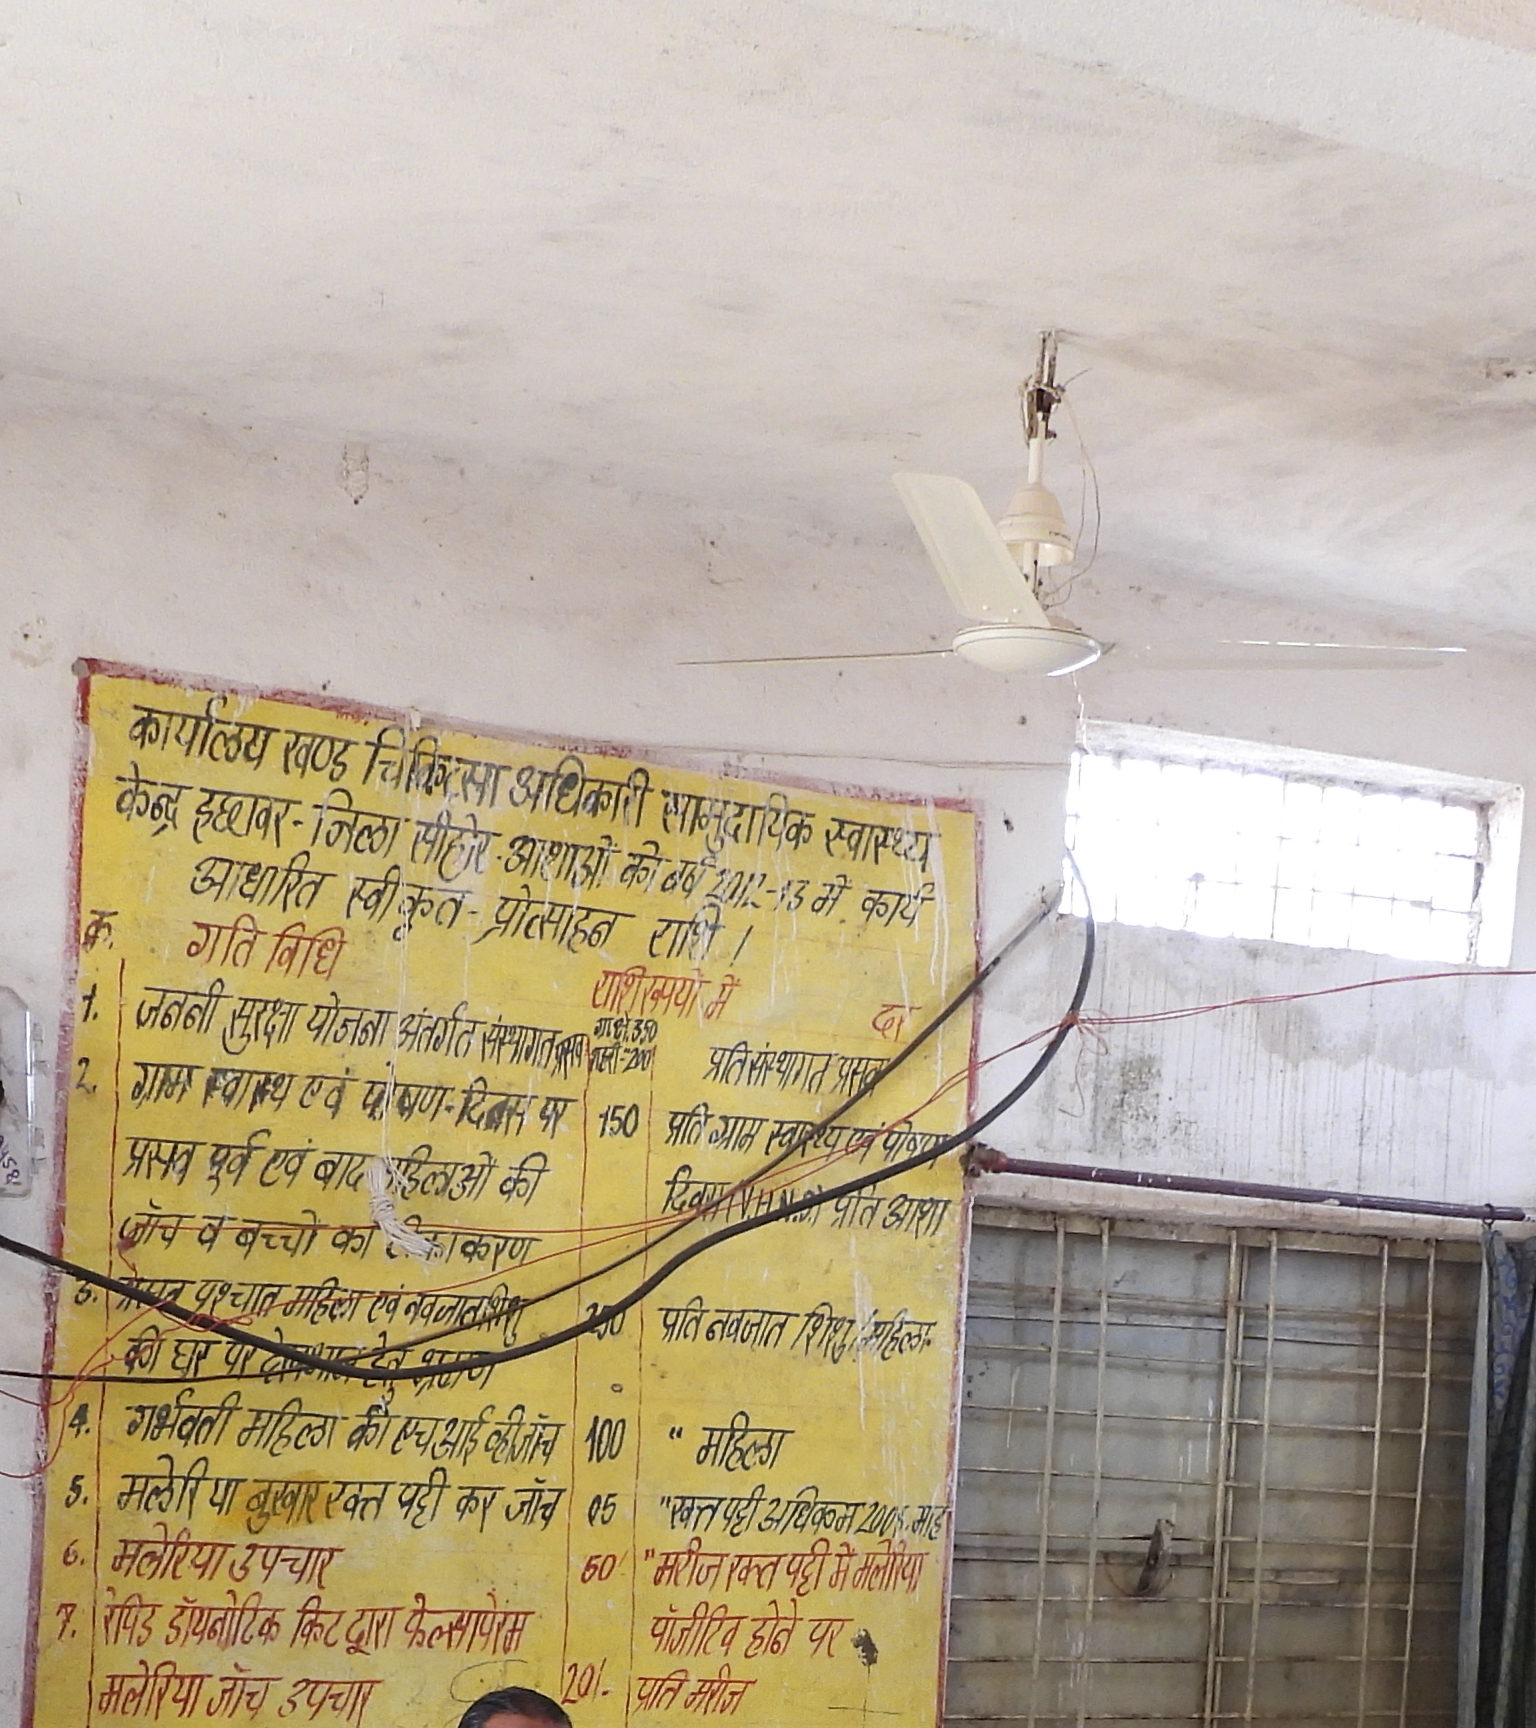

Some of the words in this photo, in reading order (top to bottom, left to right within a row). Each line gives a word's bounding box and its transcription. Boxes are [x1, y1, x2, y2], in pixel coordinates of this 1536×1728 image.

[129, 696, 275, 770] कार्यालय
[509, 755, 654, 827] अधिकारी
[620, 841, 660, 891] को
[136, 978, 234, 1032] जननी
[306, 992, 398, 1048] योजना
[598, 1106, 640, 1138] 150
[500, 1152, 551, 1206] की
[237, 1397, 348, 1457] महिला
[585, 1416, 626, 1464] 100
